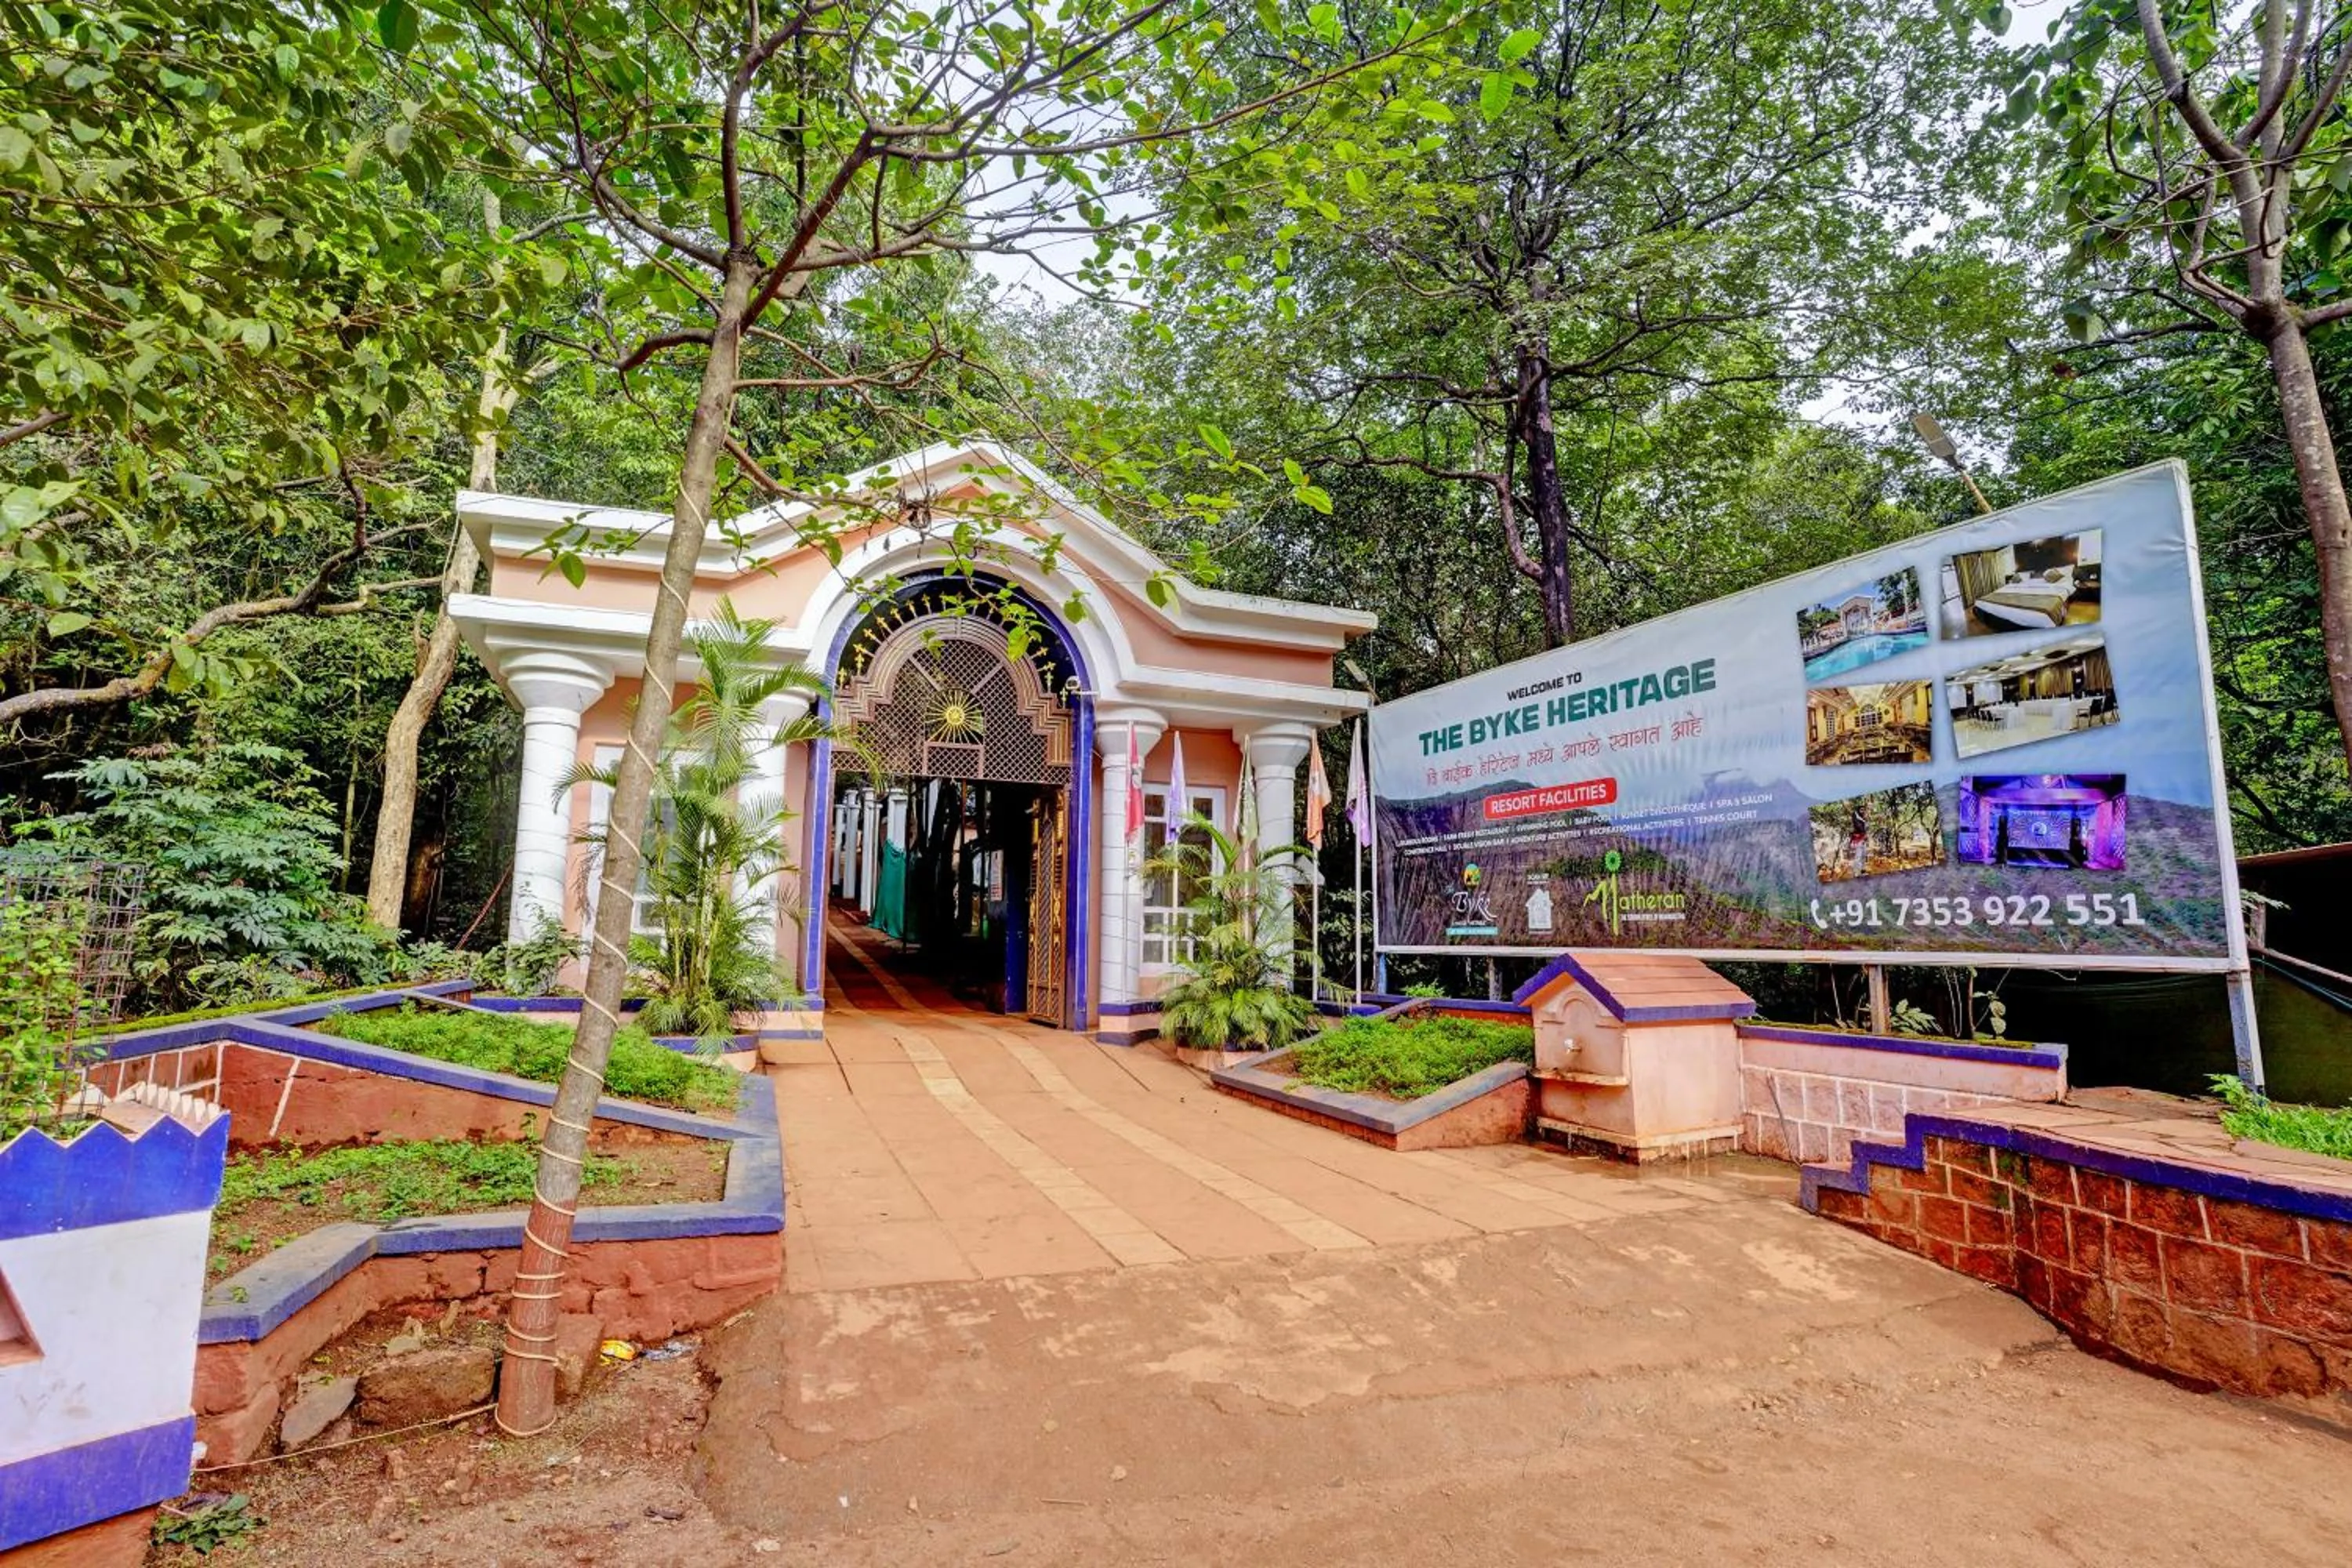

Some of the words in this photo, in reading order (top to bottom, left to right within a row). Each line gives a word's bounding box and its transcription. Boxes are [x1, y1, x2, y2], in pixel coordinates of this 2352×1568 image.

[1507, 677, 1563, 702] WELCOME
[1566, 672, 1582, 684] TO
[1419, 724, 1464, 757] THE
[1469, 704, 1540, 746] BYKE
[1546, 658, 1716, 728] HERITAGE
[1561, 732, 1601, 760] आपले
[1608, 725, 1661, 753] स्वागत
[1671, 712, 1704, 741] आहे
[1492, 794, 1536, 813] RESORT
[1539, 784, 1606, 807] FACILITIES
[1717, 798, 1733, 808] SPA
[1741, 793, 1773, 805] SALON
[1643, 818, 1685, 829] ACTIVITIES
[1693, 812, 1726, 825] TENNIS
[1726, 810, 1758, 821] COURT
[1830, 898, 1882, 927] +91
[1892, 897, 1973, 927] 7353
[1983, 895, 2053, 926] 922
[2066, 893, 2146, 926] 551
